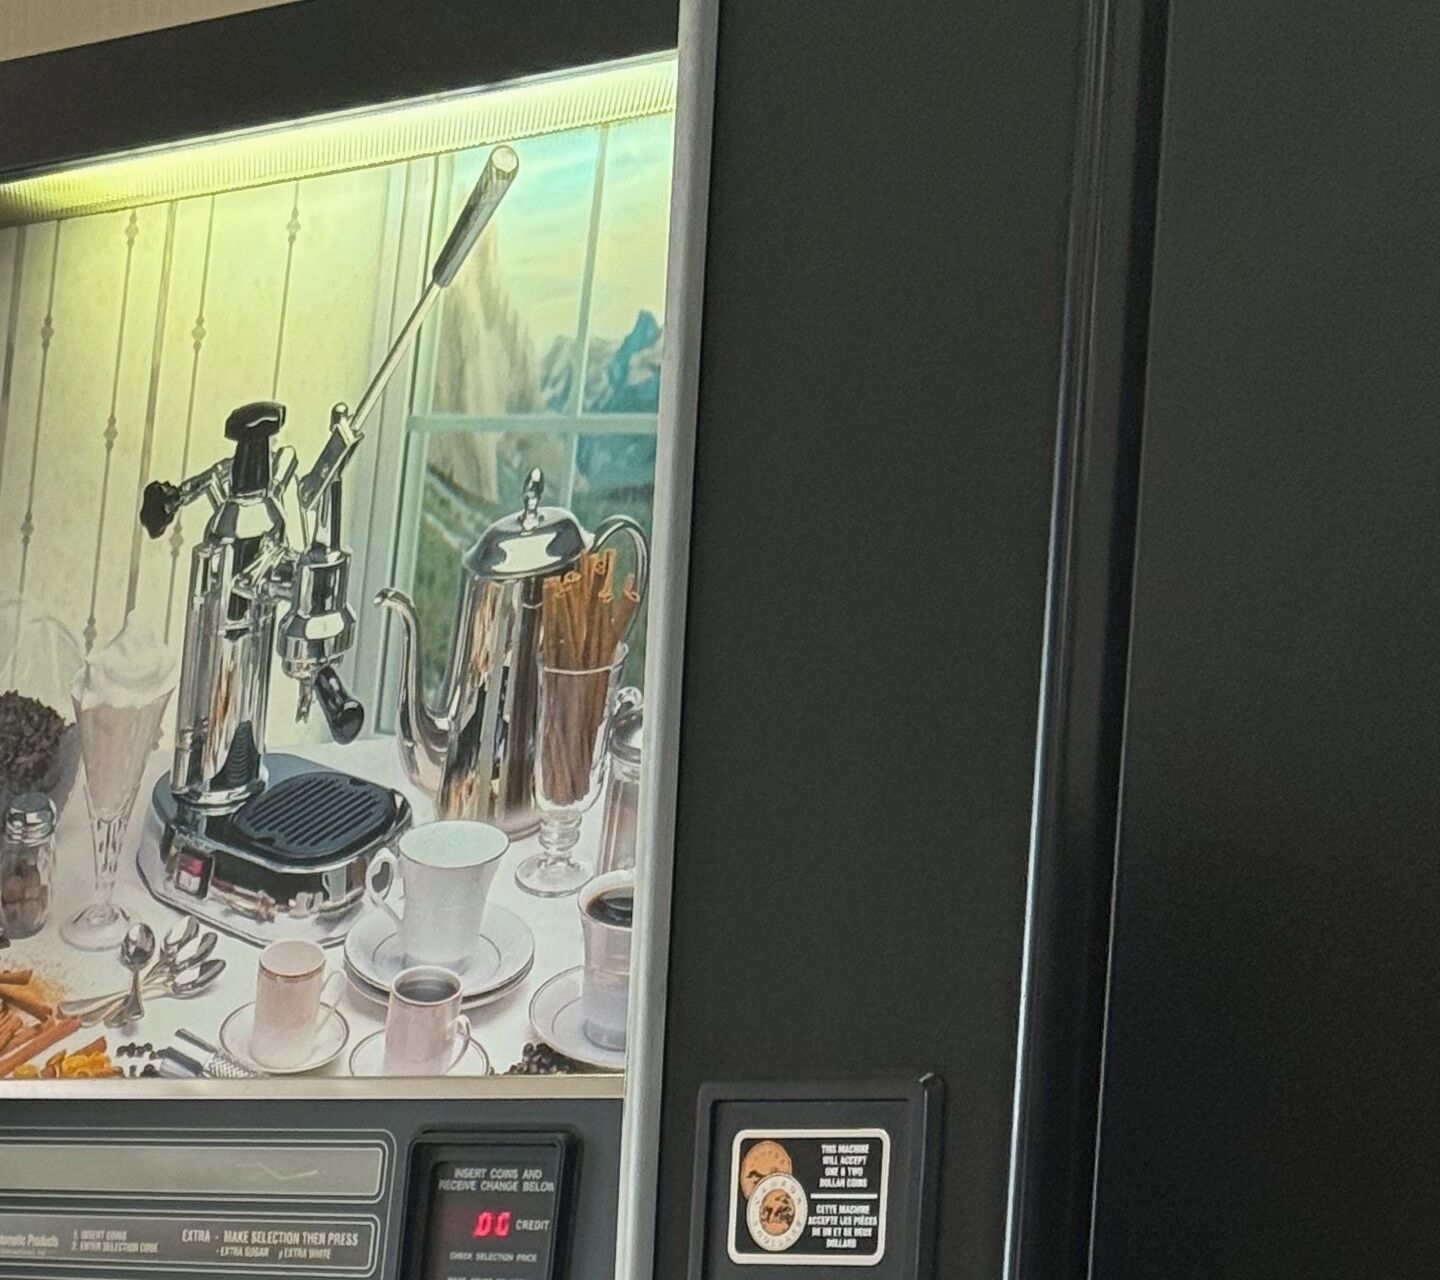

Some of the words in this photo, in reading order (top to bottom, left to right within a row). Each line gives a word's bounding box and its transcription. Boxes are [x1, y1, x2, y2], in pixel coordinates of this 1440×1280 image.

[454, 1168, 487, 1179] INSERT
[490, 1169, 518, 1179] COINS
[522, 1169, 542, 1180] AND
[438, 1180, 477, 1191] RECEIVE
[480, 1181, 519, 1191] CHANGE
[522, 1182, 554, 1192] BELOW
[515, 1219, 550, 1231] CREDIT
[182, 1229, 211, 1243] EXTRA
[223, 1230, 250, 1244] MAKE
[251, 1231, 301, 1245] SELECTION
[302, 1232, 326, 1246] THEN
[327, 1232, 359, 1247] PRESS
